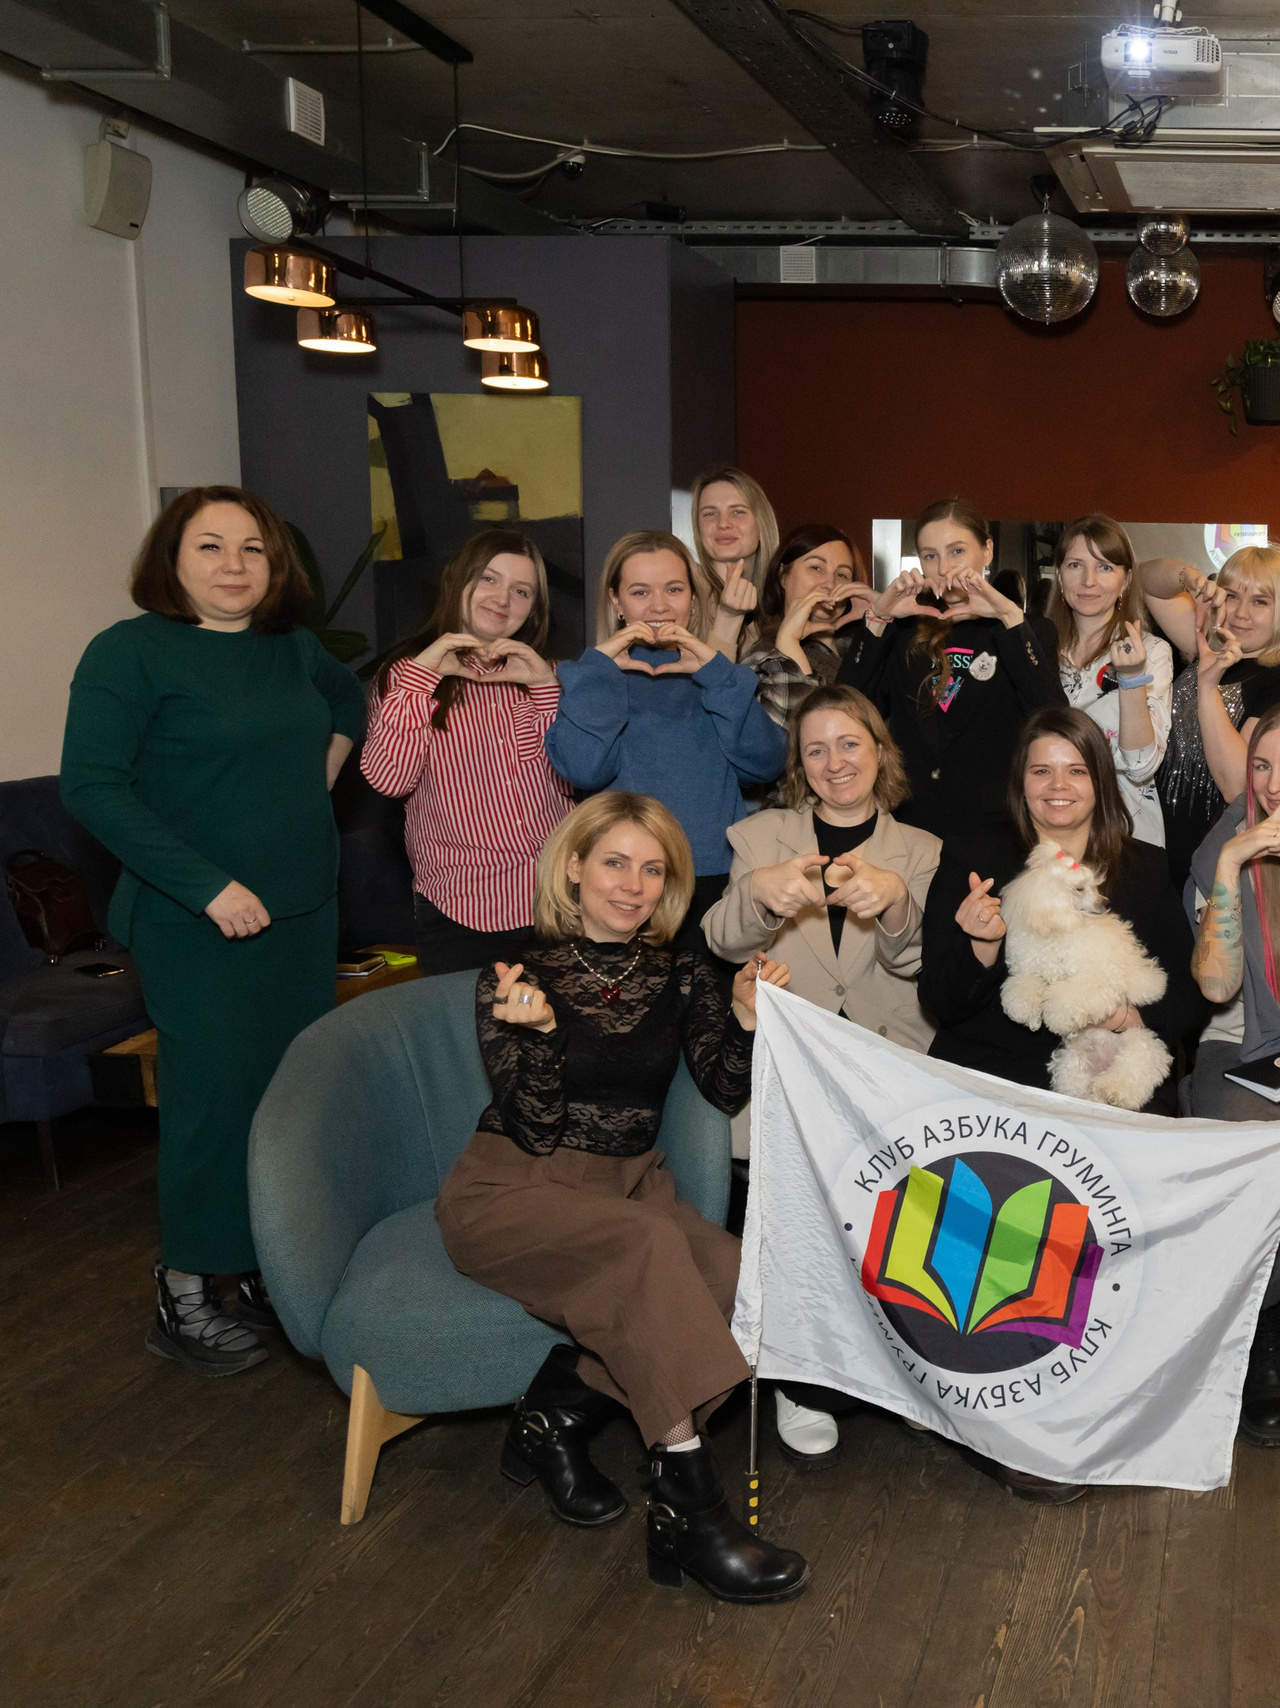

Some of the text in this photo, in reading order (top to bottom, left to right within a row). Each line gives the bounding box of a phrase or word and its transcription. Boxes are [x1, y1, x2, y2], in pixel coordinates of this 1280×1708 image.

[854, 1115, 1132, 1257] КЛУБ АЗБУКА ГРУМИНГА
[1050, 1318, 1112, 1384] КЛУБ
[937, 1373, 1041, 1409] АЗБУКА
